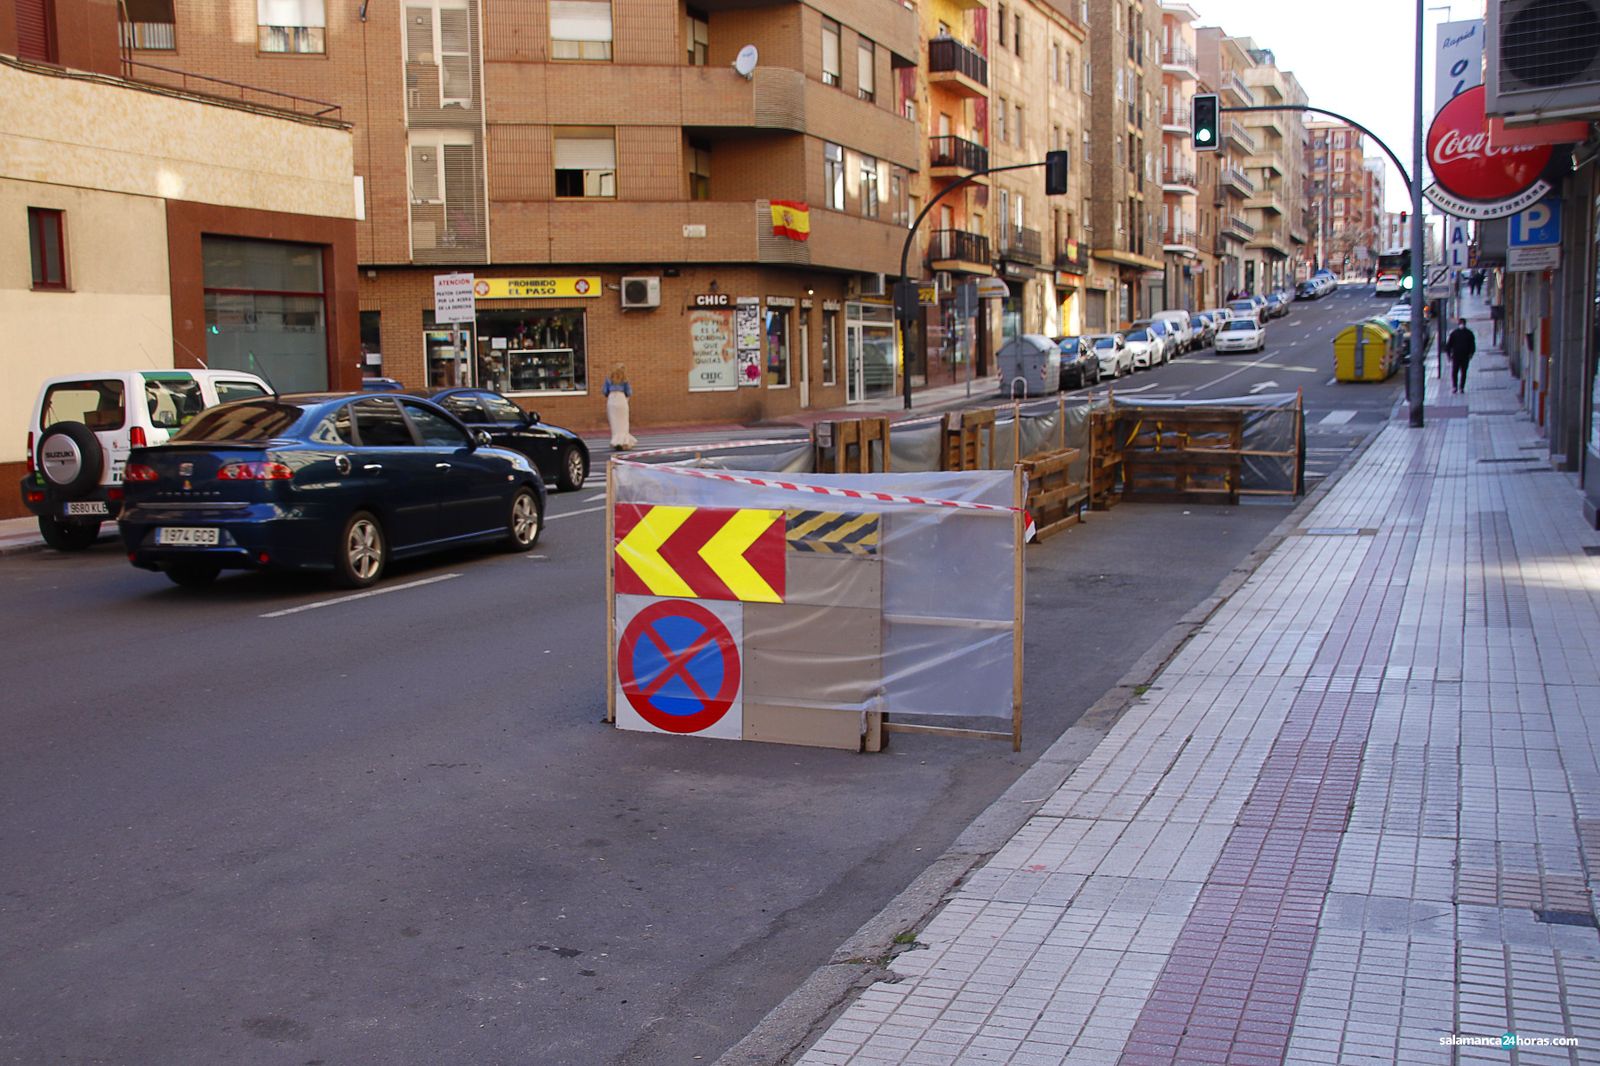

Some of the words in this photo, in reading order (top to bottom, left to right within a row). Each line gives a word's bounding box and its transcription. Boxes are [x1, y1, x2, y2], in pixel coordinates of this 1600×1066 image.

[1483, 183, 1546, 216] ASTURIANA
[1519, 203, 1551, 242] P
[508, 279, 557, 287] PROHIBIDO
[526, 287, 556, 295] PASO
[696, 295, 728, 305] CHIC
[700, 371, 723, 380] CHIC
[45, 450, 75, 459] SUZUKI
[164, 528, 190, 542] 1974
